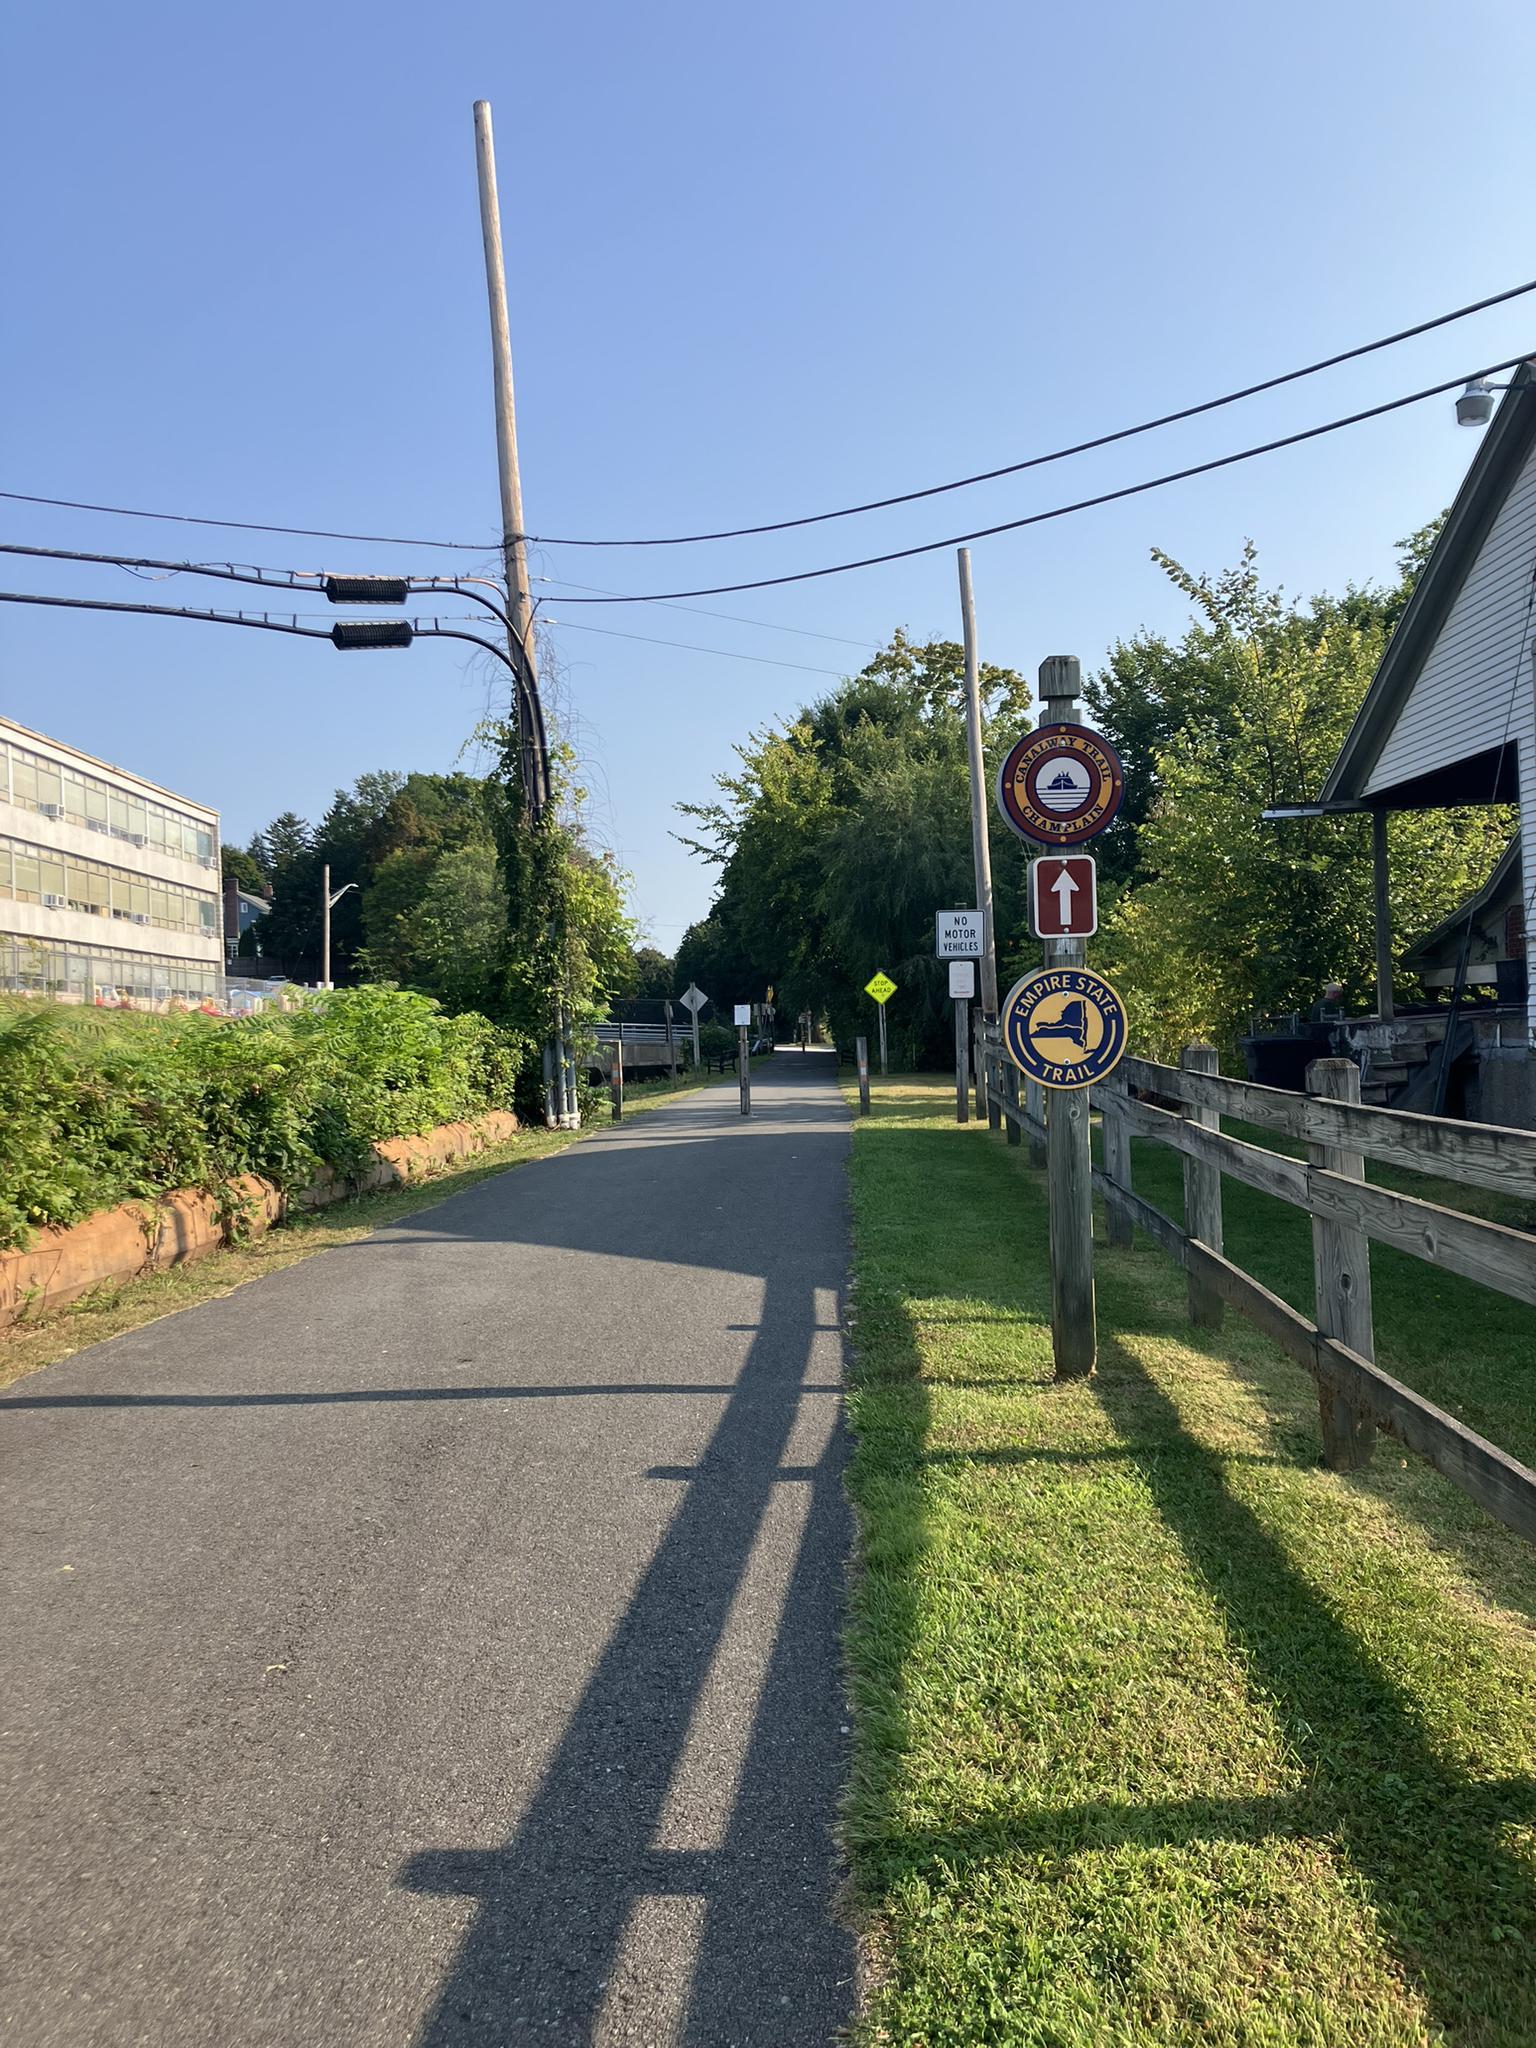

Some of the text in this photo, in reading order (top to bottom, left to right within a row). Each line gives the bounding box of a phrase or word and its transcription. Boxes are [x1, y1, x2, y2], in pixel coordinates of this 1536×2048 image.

[1015, 737, 1111, 784] CANALWAY TRAIL
[1023, 804, 1104, 832] CHAMPLAIN
[954, 916, 968, 926] NO
[944, 929, 976, 939] MOTOR
[943, 942, 978, 952] VEHICLES
[1015, 975, 1117, 1017] EMPIRE STATE
[1042, 1064, 1095, 1082] TRAIL
